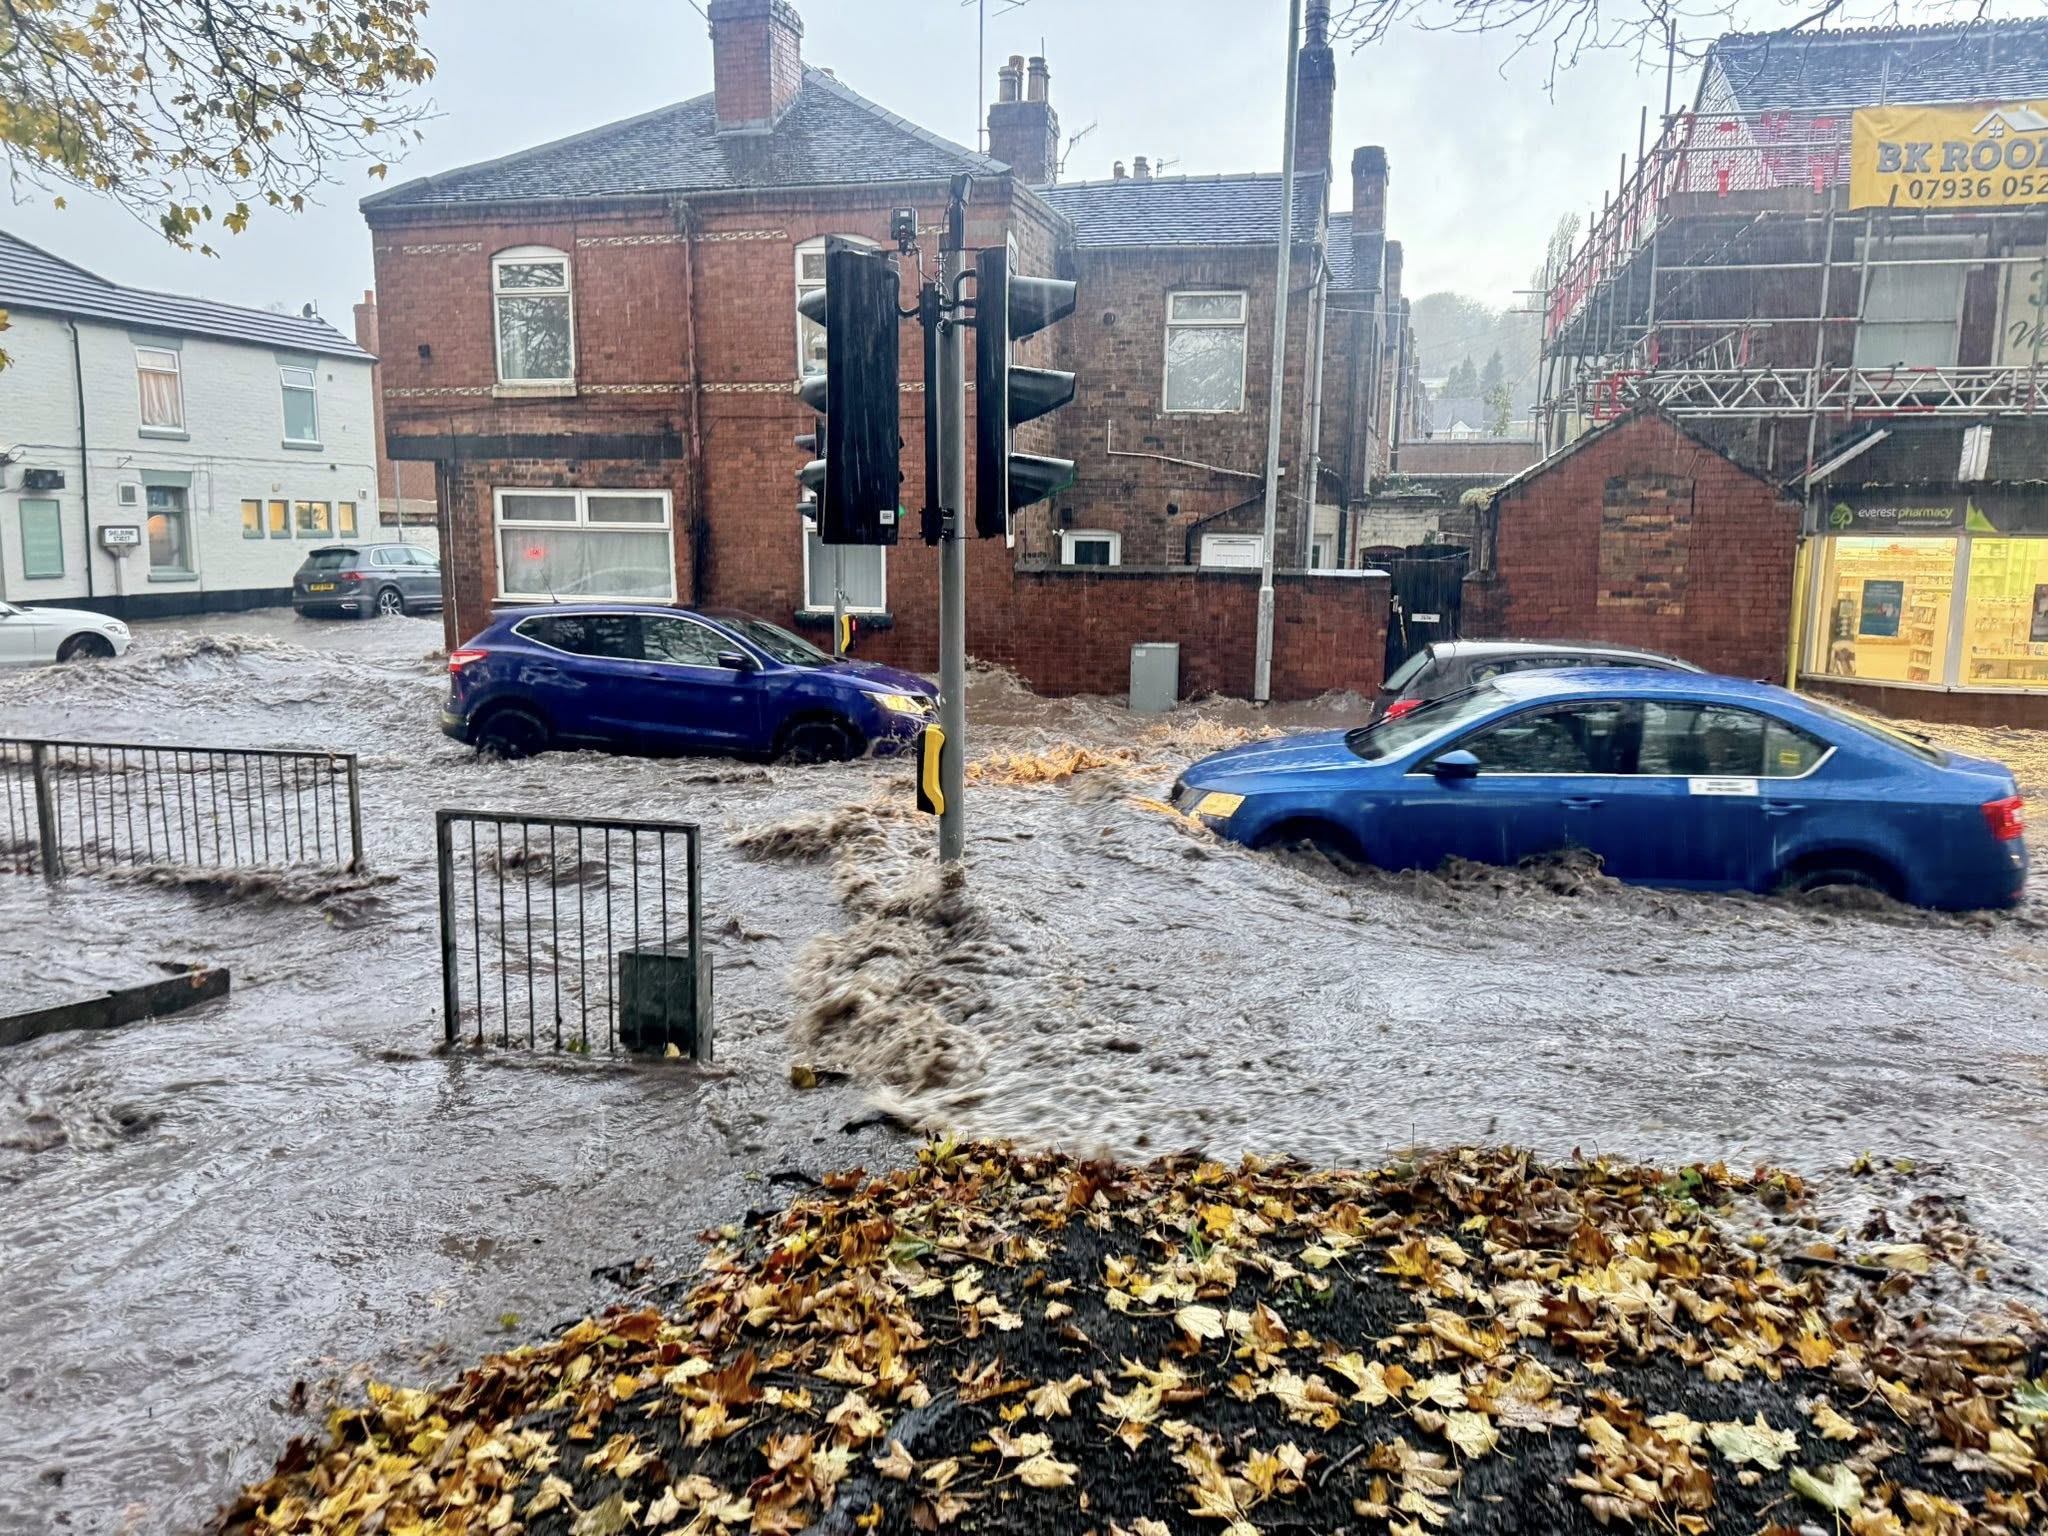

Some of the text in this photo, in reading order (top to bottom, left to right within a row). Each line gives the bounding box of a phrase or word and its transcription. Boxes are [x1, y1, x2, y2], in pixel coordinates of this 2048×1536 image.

[1877, 141, 1933, 173] BK
[1909, 177, 1991, 200] 07936
[1858, 507, 1954, 519] everest pharmacy
